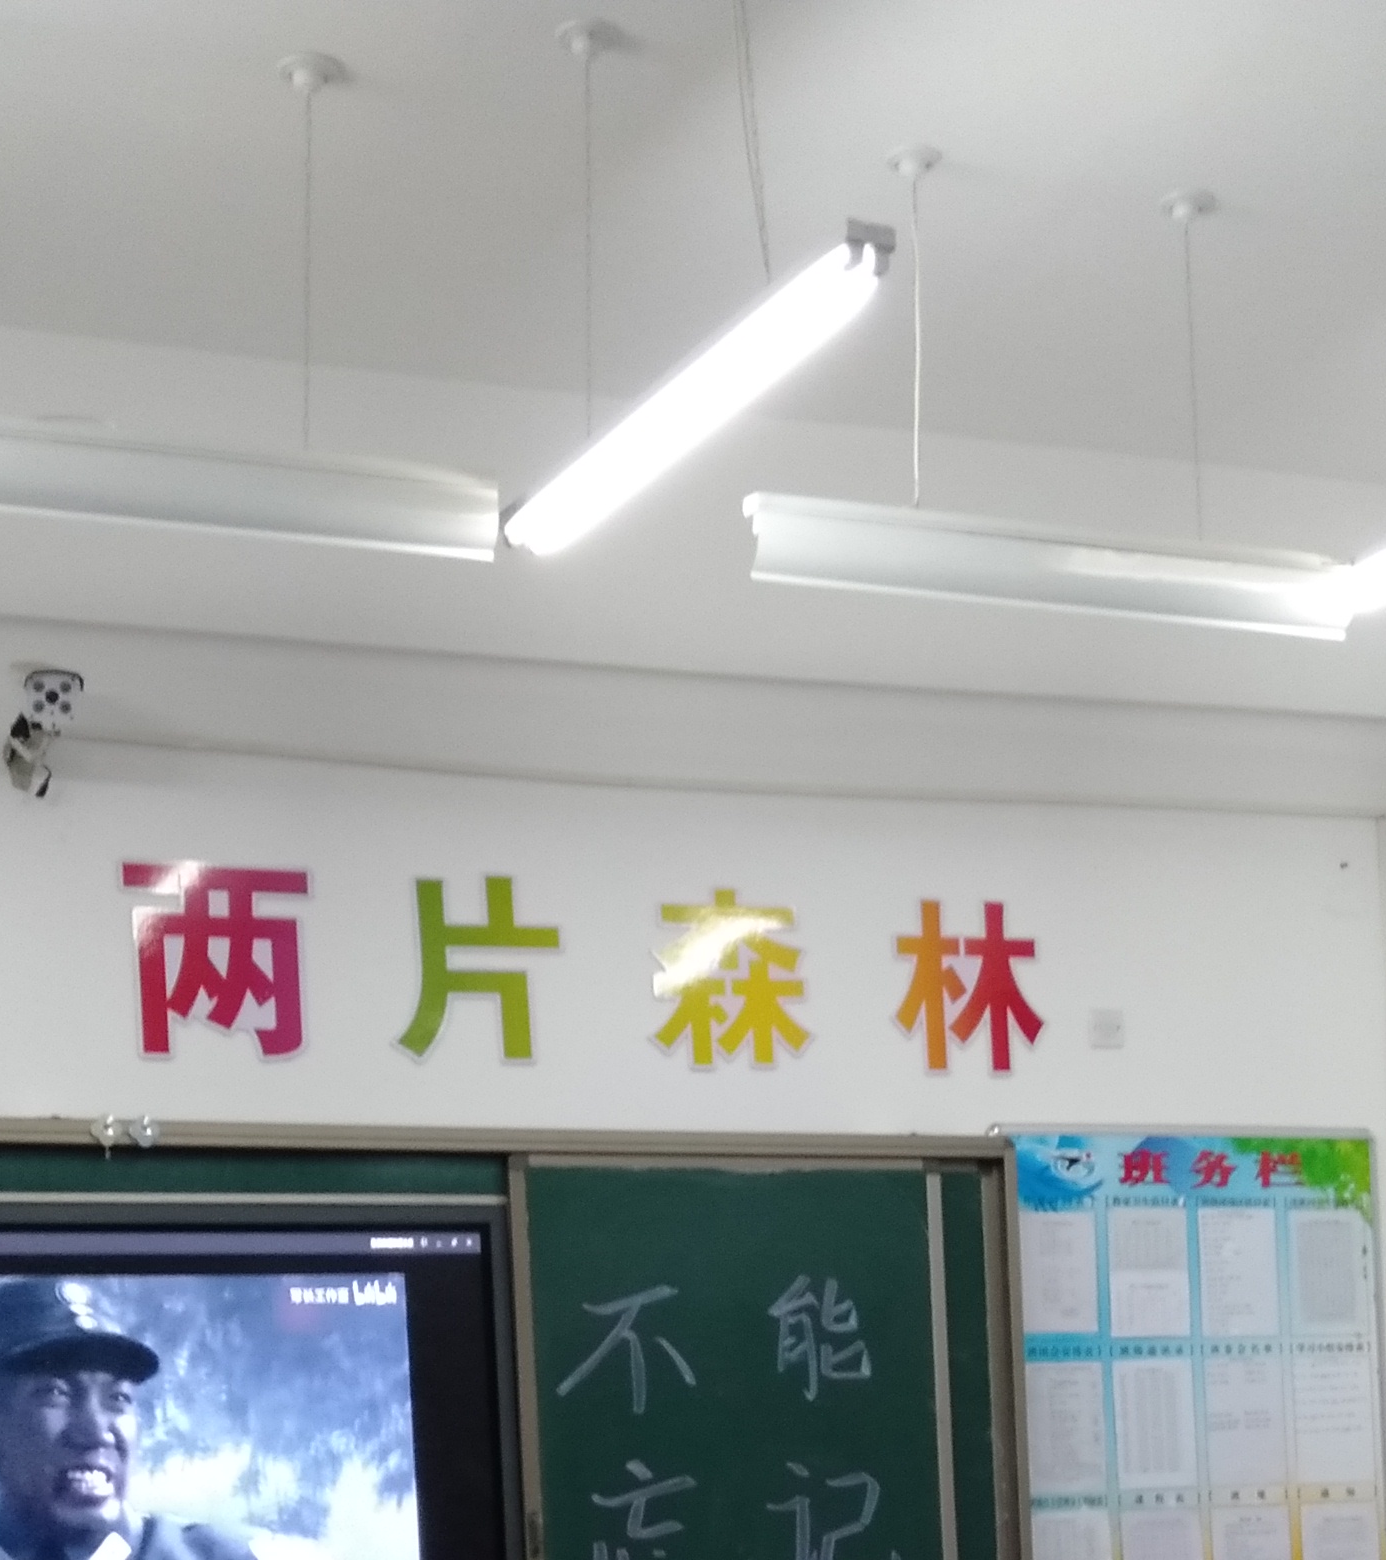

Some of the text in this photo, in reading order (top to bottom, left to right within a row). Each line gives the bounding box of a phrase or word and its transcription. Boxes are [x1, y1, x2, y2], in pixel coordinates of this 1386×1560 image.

[120, 860, 1044, 1072] 两片森林
[1118, 1148, 1309, 1189] 班务栏
[556, 1274, 873, 1415] 不能
